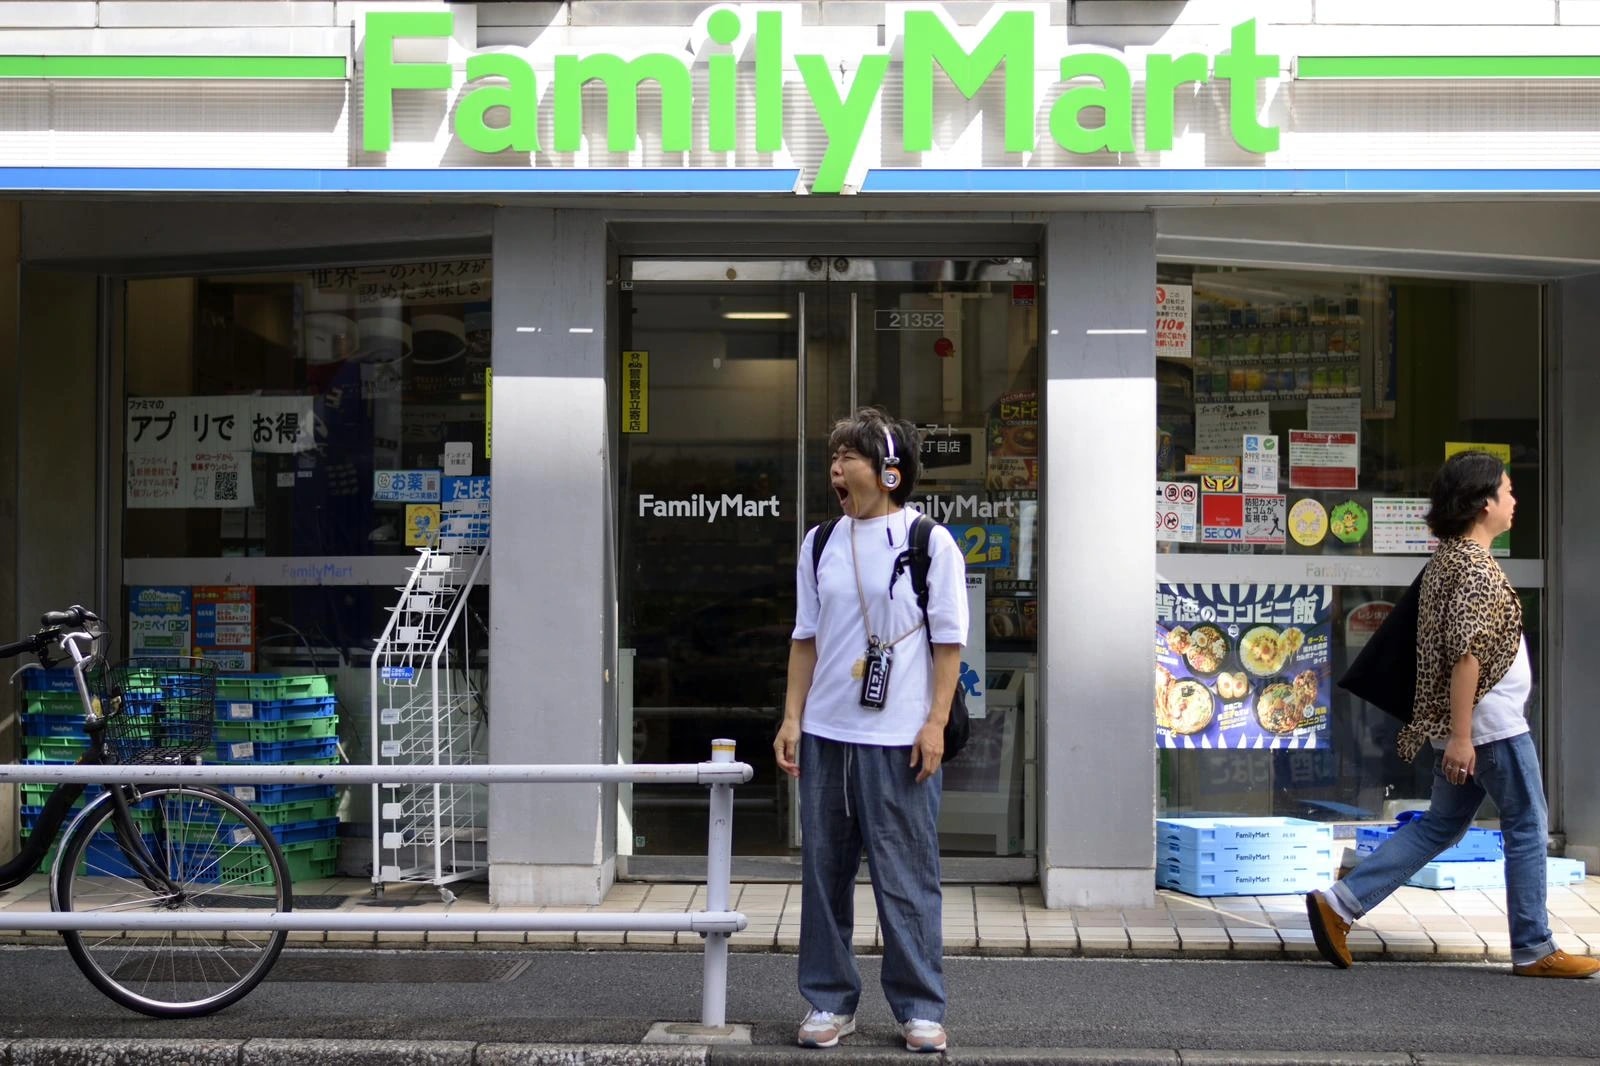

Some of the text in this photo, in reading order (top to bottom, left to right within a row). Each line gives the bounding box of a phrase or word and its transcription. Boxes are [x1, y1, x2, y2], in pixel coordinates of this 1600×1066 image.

[364, 11, 1279, 193] FamilyMart
[889, 312, 944, 327] 21352
[128, 399, 165, 409] ファミマの
[392, 472, 423, 491] お薬
[639, 493, 780, 522] FamilyMart
[1245, 498, 1285, 507] 防犯カメラで
[905, 494, 1016, 524] milyMart
[1246, 507, 1274, 515] セコムが
[1245, 515, 1268, 523] 監視中
[1204, 527, 1241, 539] SECOM
[281, 563, 353, 581] FamilyMart
[1236, 831, 1270, 839] FamilyMart
[1236, 853, 1270, 862] FamilyMart
[1236, 876, 1270, 884] FamilyMart
